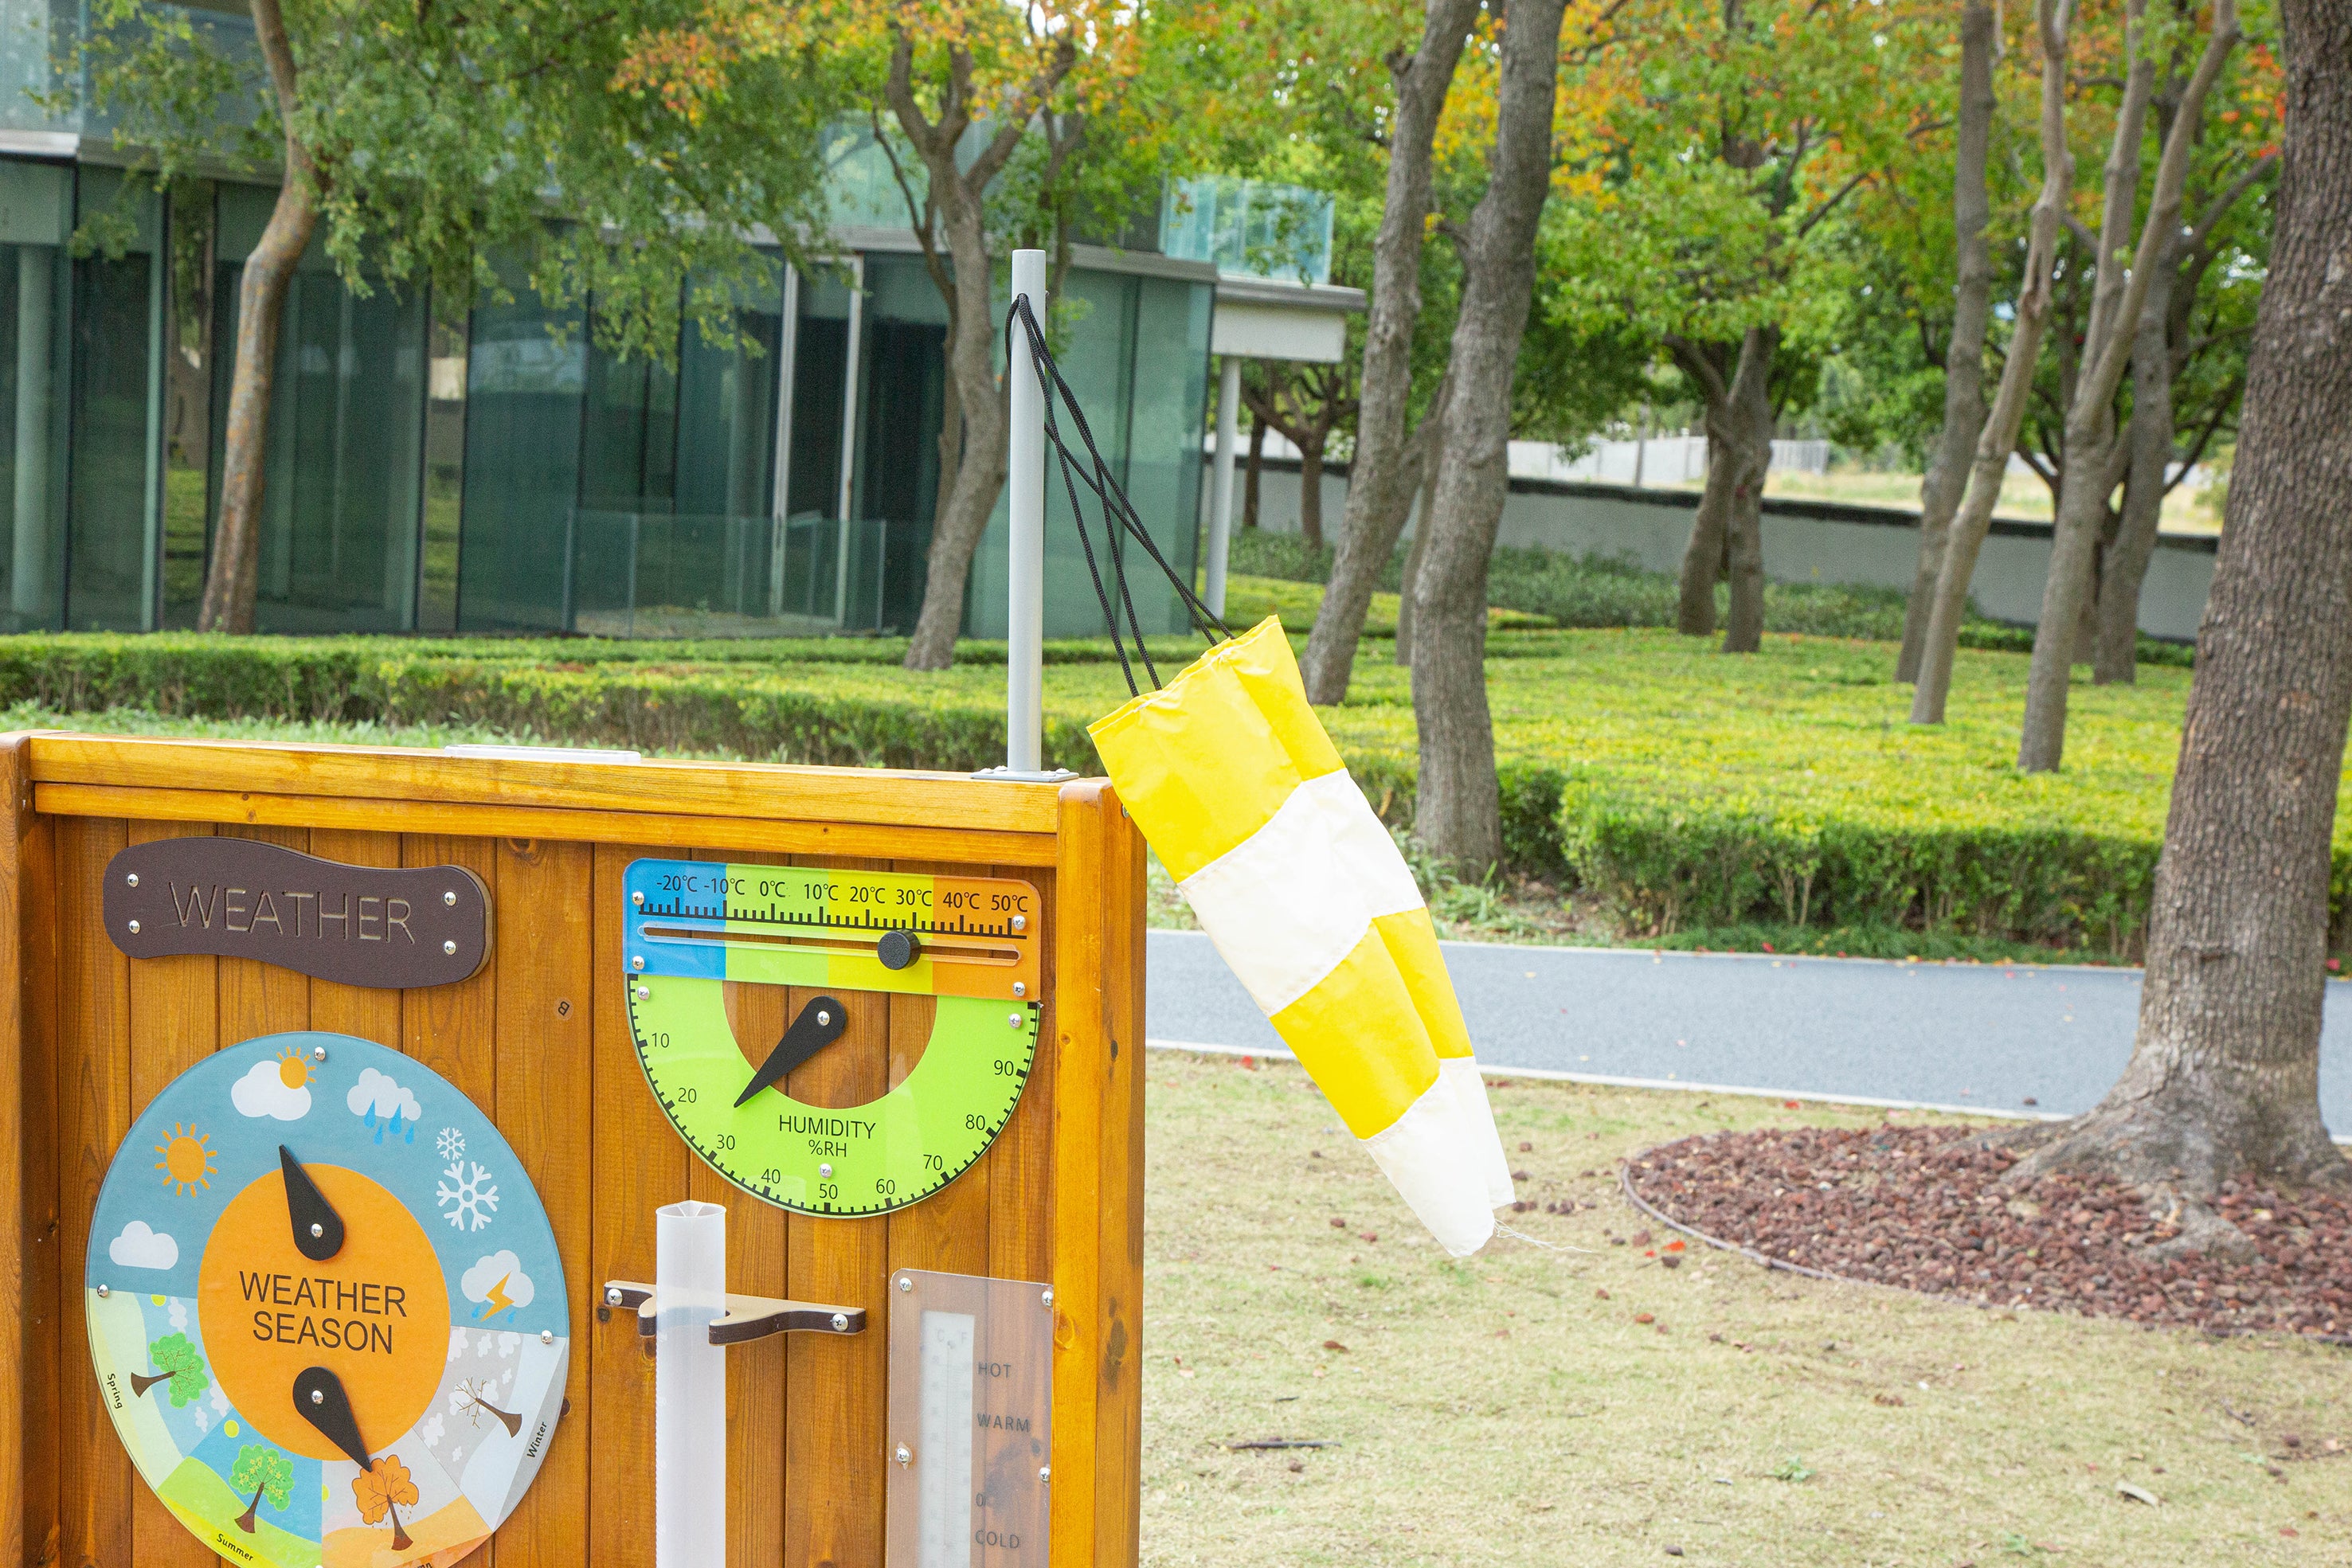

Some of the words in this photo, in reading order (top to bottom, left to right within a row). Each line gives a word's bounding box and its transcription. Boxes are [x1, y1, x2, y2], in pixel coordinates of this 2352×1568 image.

[656, 874, 698, 893] -20°C
[703, 878, 746, 895] -10°C
[760, 881, 785, 897] 0°C
[804, 884, 838, 901] 10°C
[850, 886, 885, 903] 20°C
[897, 890, 932, 906] 30°C
[943, 892, 980, 909] 40°C
[992, 895, 1027, 912] 50°C
[169, 881, 415, 944] WEATHER
[558, 1001, 569, 1016] B
[652, 1033, 669, 1047] 10
[995, 1060, 1013, 1076] 90
[679, 1088, 696, 1103] 20
[778, 1114, 876, 1140] HUMIDITY
[966, 1115, 985, 1130] 80
[716, 1134, 735, 1151] 30
[808, 1140, 847, 1158] %RH
[924, 1155, 942, 1170] 70
[761, 1169, 780, 1183] 40
[820, 1184, 837, 1199] 50
[876, 1179, 894, 1195] 60
[239, 1271, 406, 1316] WEATHER
[252, 1310, 392, 1354] SEASON
[979, 1363, 1011, 1378] HOT
[107, 1373, 123, 1410] Spring
[977, 1413, 1031, 1433] WARM
[526, 1421, 547, 1458] Winter
[216, 1533, 254, 1561] Summer
[975, 1529, 1019, 1549] COLD
